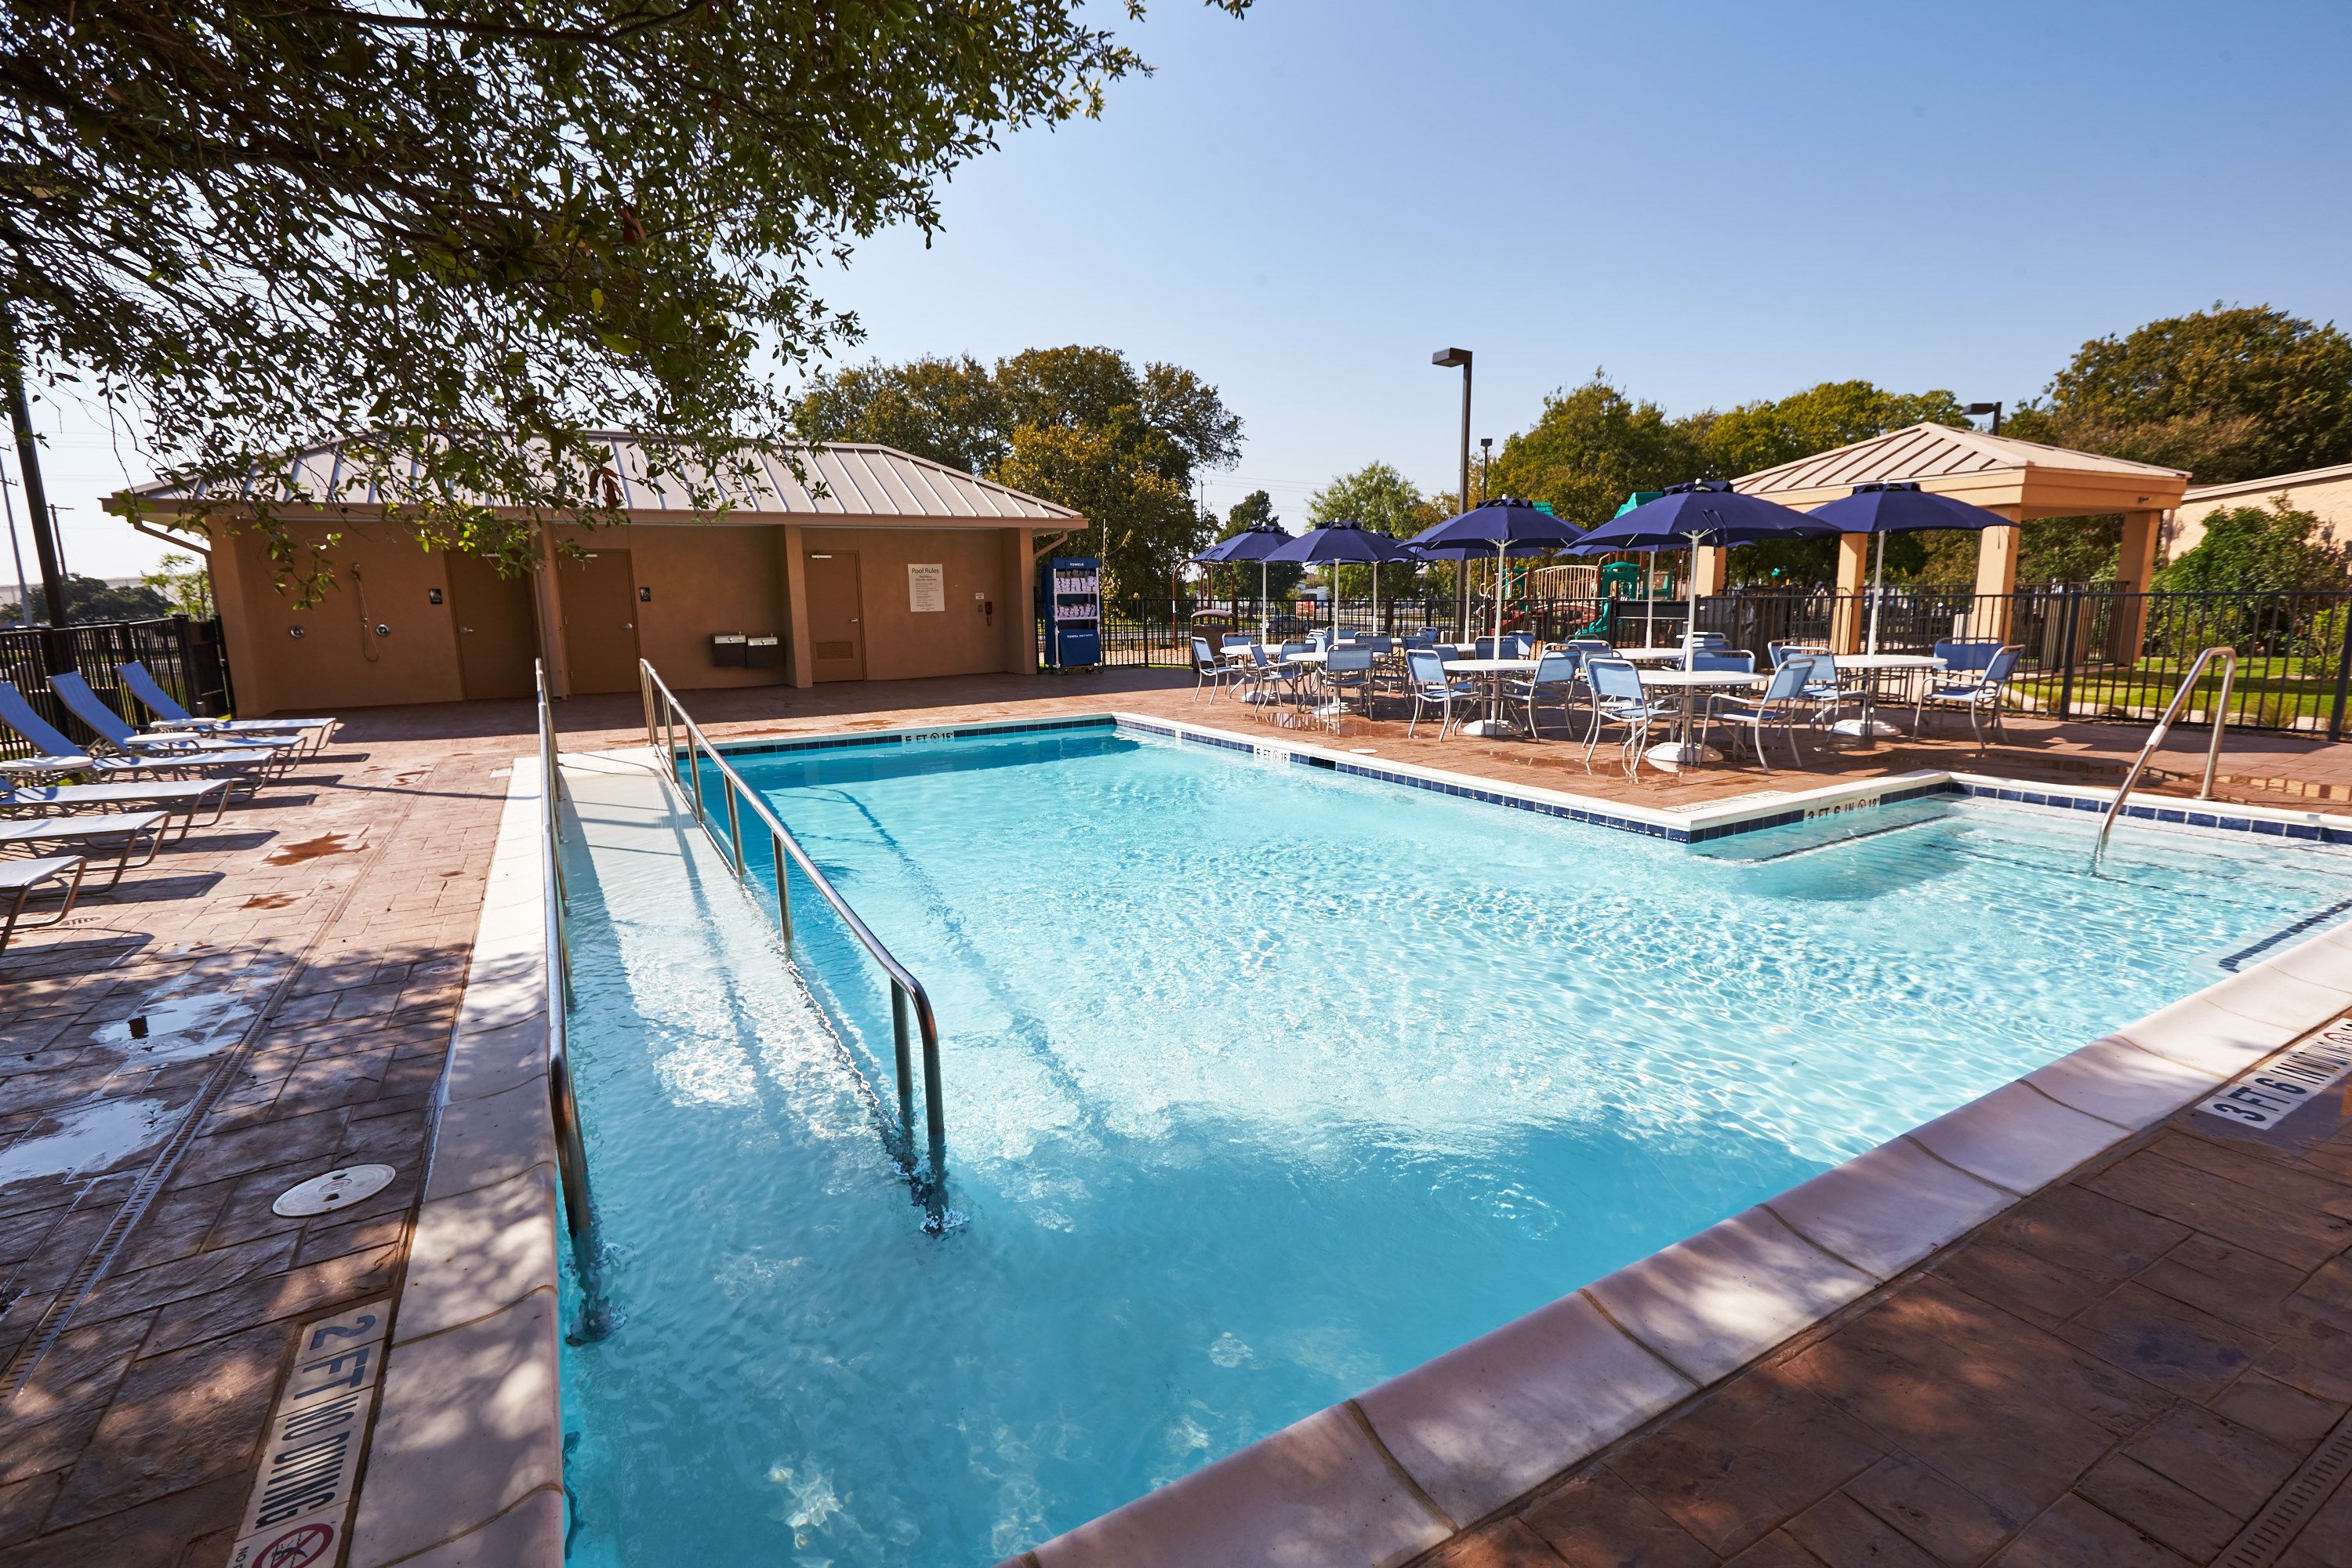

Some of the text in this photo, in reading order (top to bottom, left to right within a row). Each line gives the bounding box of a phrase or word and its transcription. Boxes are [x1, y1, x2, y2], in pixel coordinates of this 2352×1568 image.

[1818, 807, 1830, 818] FT
[2285, 1054, 2341, 1073] NO
[2269, 1062, 2331, 1085] IN
[2254, 1077, 2307, 1094] 6
[2227, 1086, 2291, 1112] FT
[2213, 1103, 2267, 1122] 3
[255, 1314, 376, 1530] 2 FT NO DIVING
[235, 1545, 249, 1563] NO
